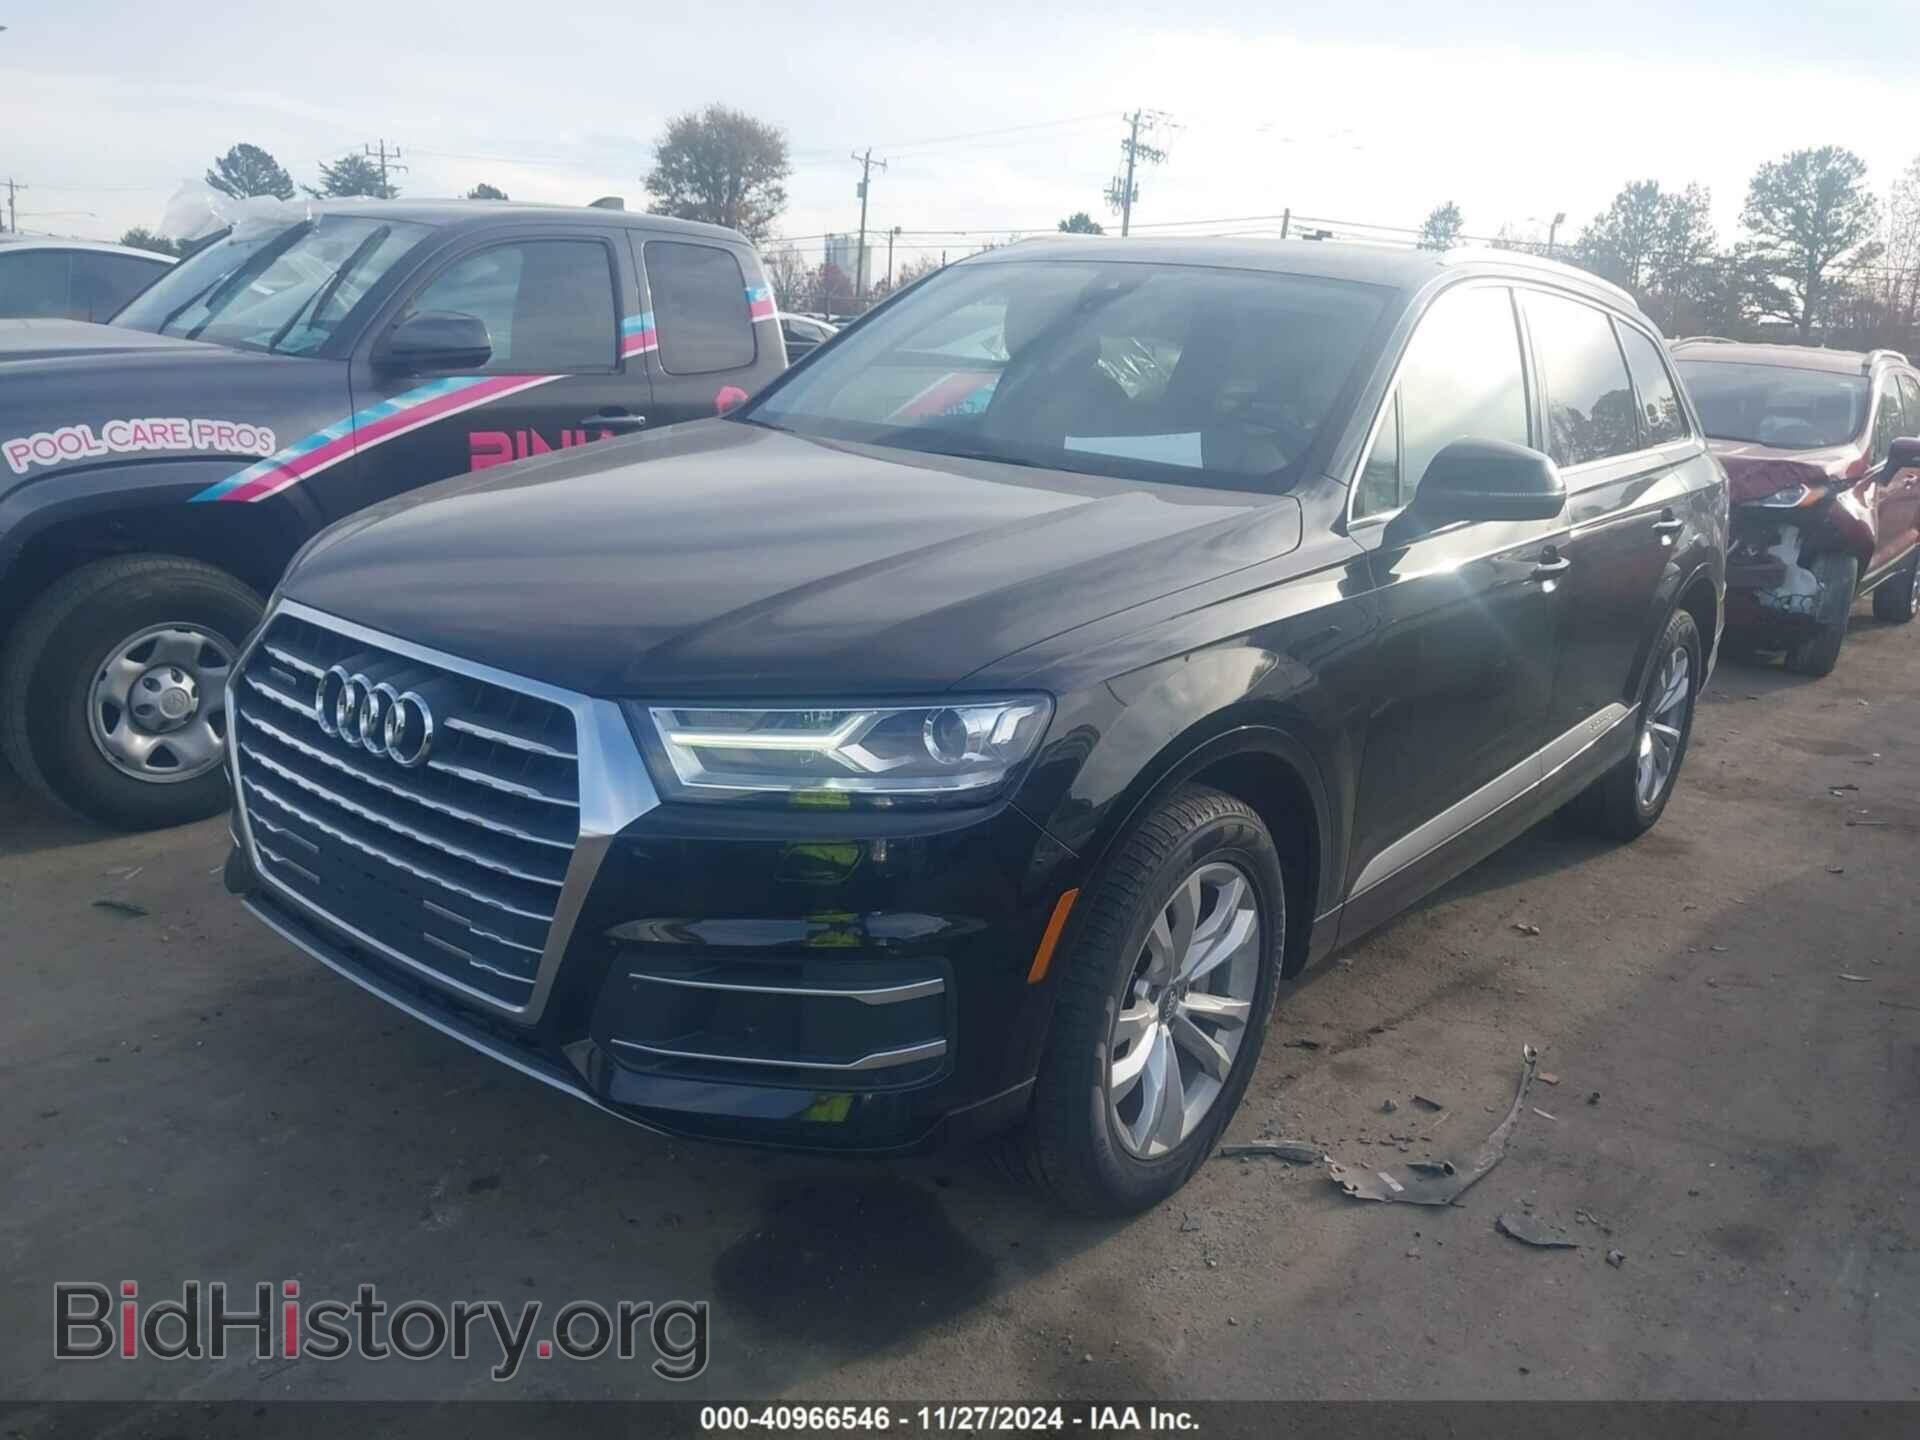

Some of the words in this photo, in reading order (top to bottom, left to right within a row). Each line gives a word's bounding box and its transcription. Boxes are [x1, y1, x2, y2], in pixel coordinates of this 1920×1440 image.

[8, 428, 103, 469] POOL
[107, 422, 188, 449] CARE
[195, 422, 273, 452] PROS
